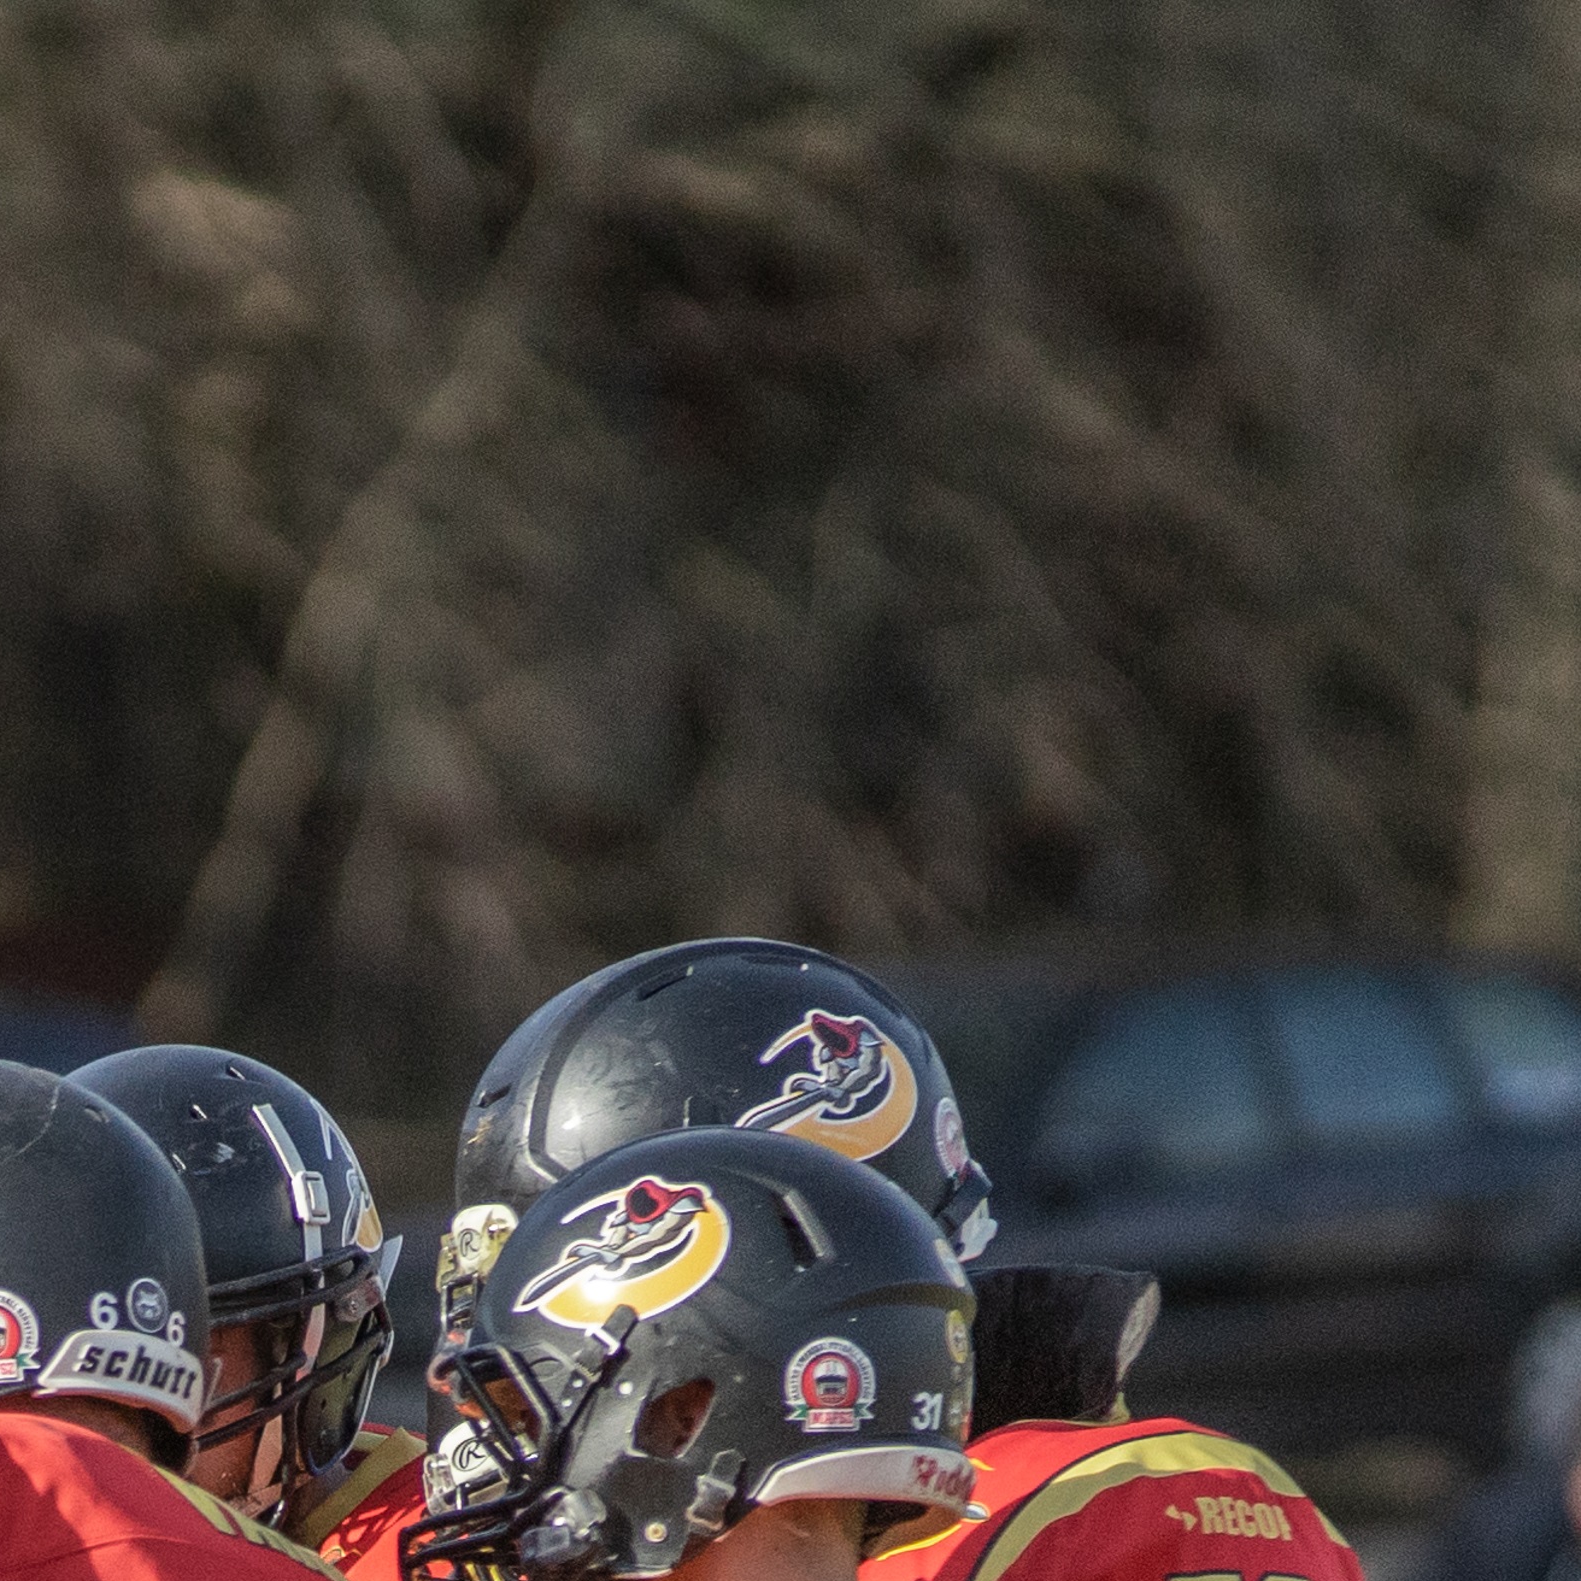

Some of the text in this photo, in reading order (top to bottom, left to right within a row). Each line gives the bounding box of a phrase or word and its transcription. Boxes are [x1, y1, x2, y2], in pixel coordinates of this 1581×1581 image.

[90, 1291, 186, 1348] 6 6
[78, 1345, 197, 1399] schutt
[911, 1391, 944, 1431] 31
